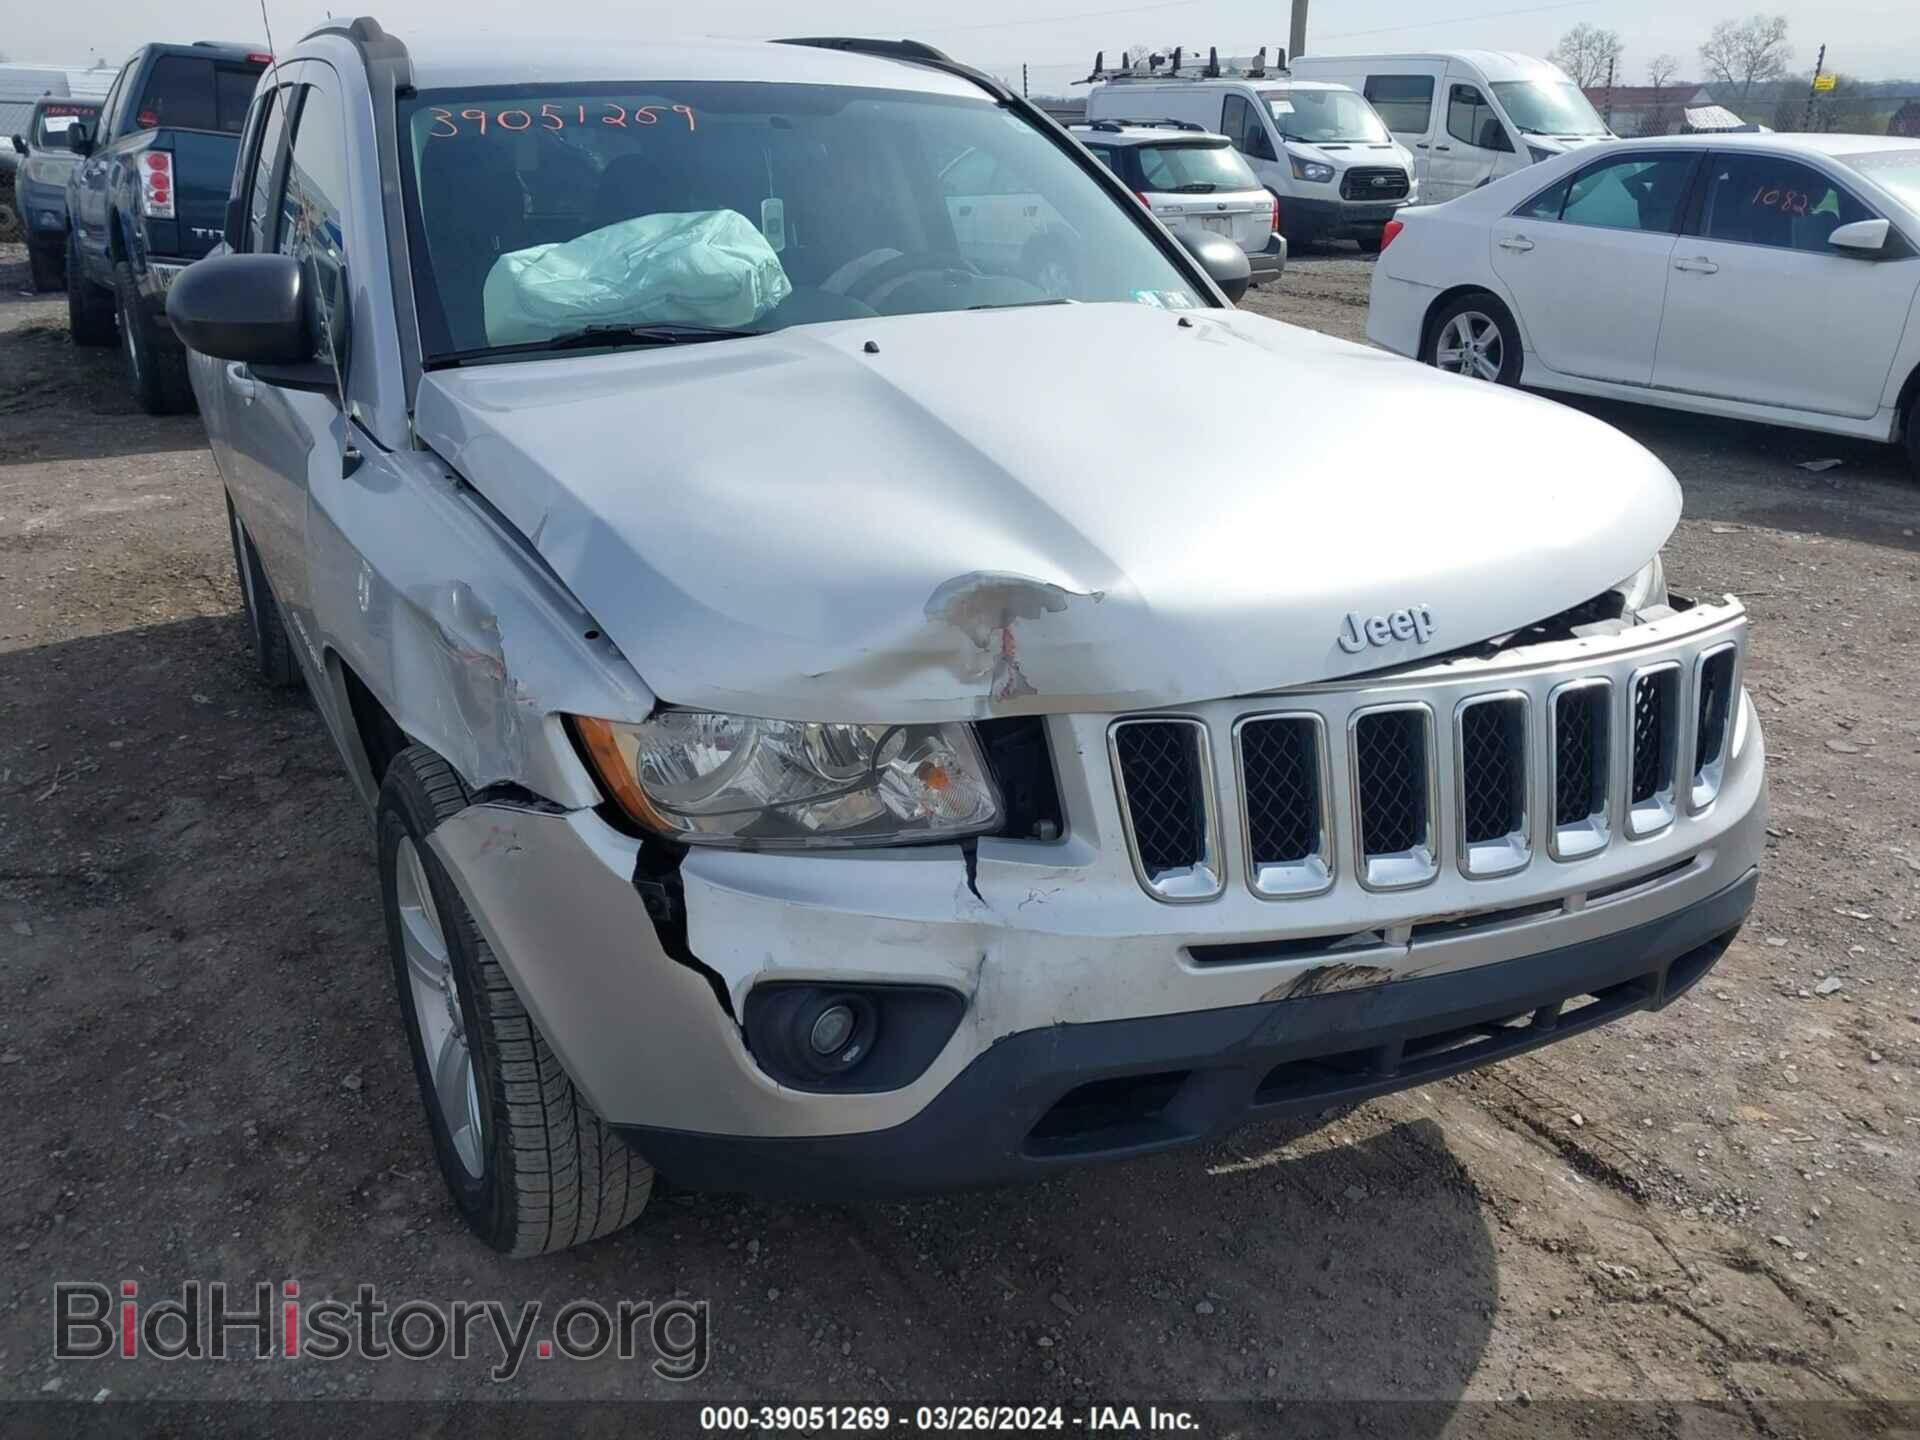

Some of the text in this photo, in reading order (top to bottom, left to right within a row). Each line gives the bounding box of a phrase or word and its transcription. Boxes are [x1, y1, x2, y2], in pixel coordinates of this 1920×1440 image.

[428, 103, 697, 138] 39051269
[191, 226, 225, 240] TIT
[1337, 602, 1435, 654] Jeep
